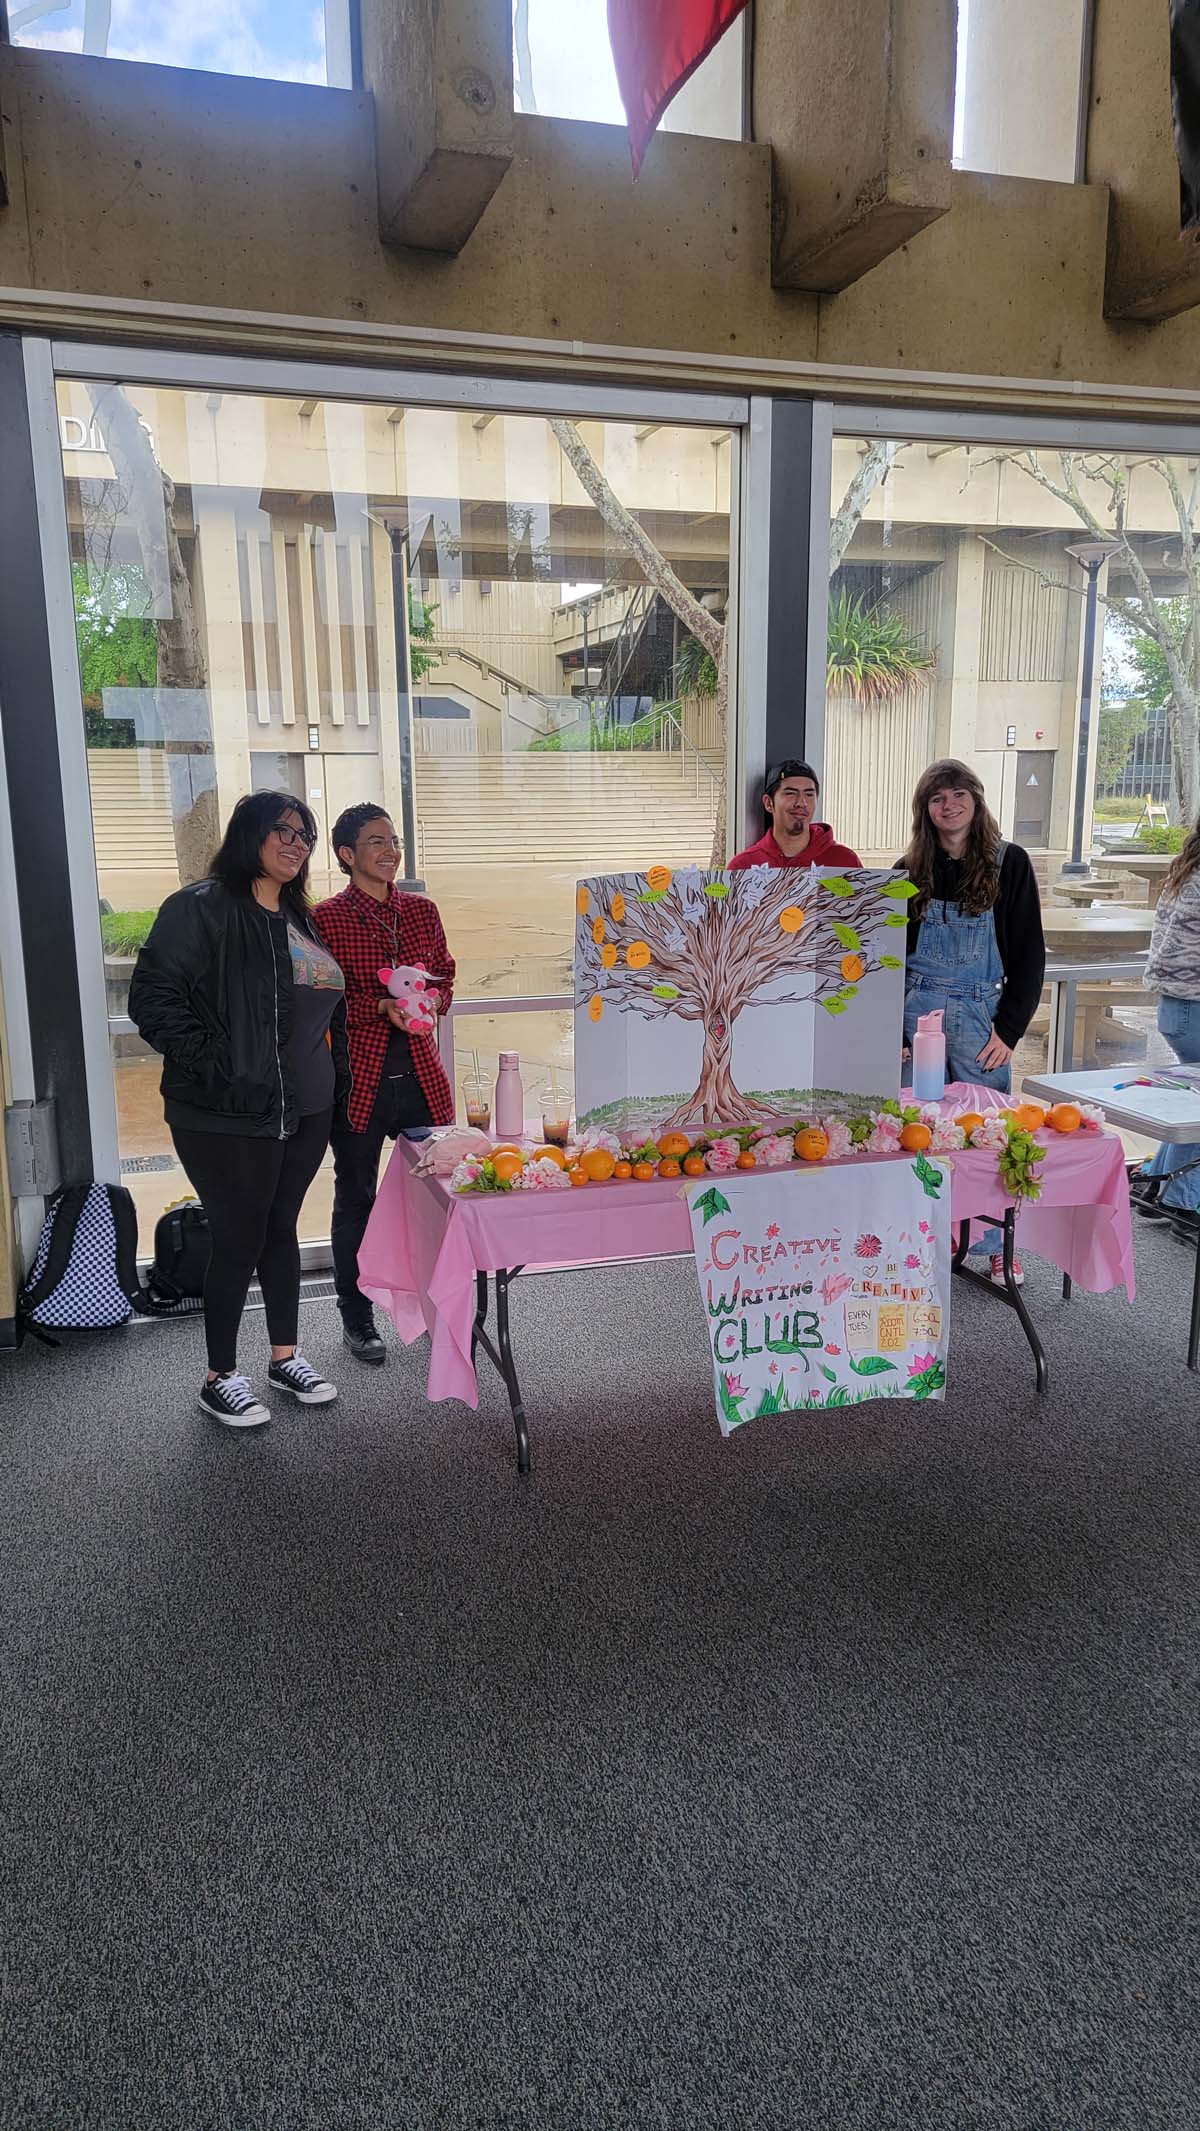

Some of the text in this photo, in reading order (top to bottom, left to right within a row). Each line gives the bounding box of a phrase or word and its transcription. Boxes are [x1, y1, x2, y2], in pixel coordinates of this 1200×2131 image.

[710, 1230, 842, 1270] CREATIVE
[707, 1275, 813, 1317] WRITING
[848, 1310, 871, 1321] EVERY
[714, 1309, 823, 1363] CLUB
